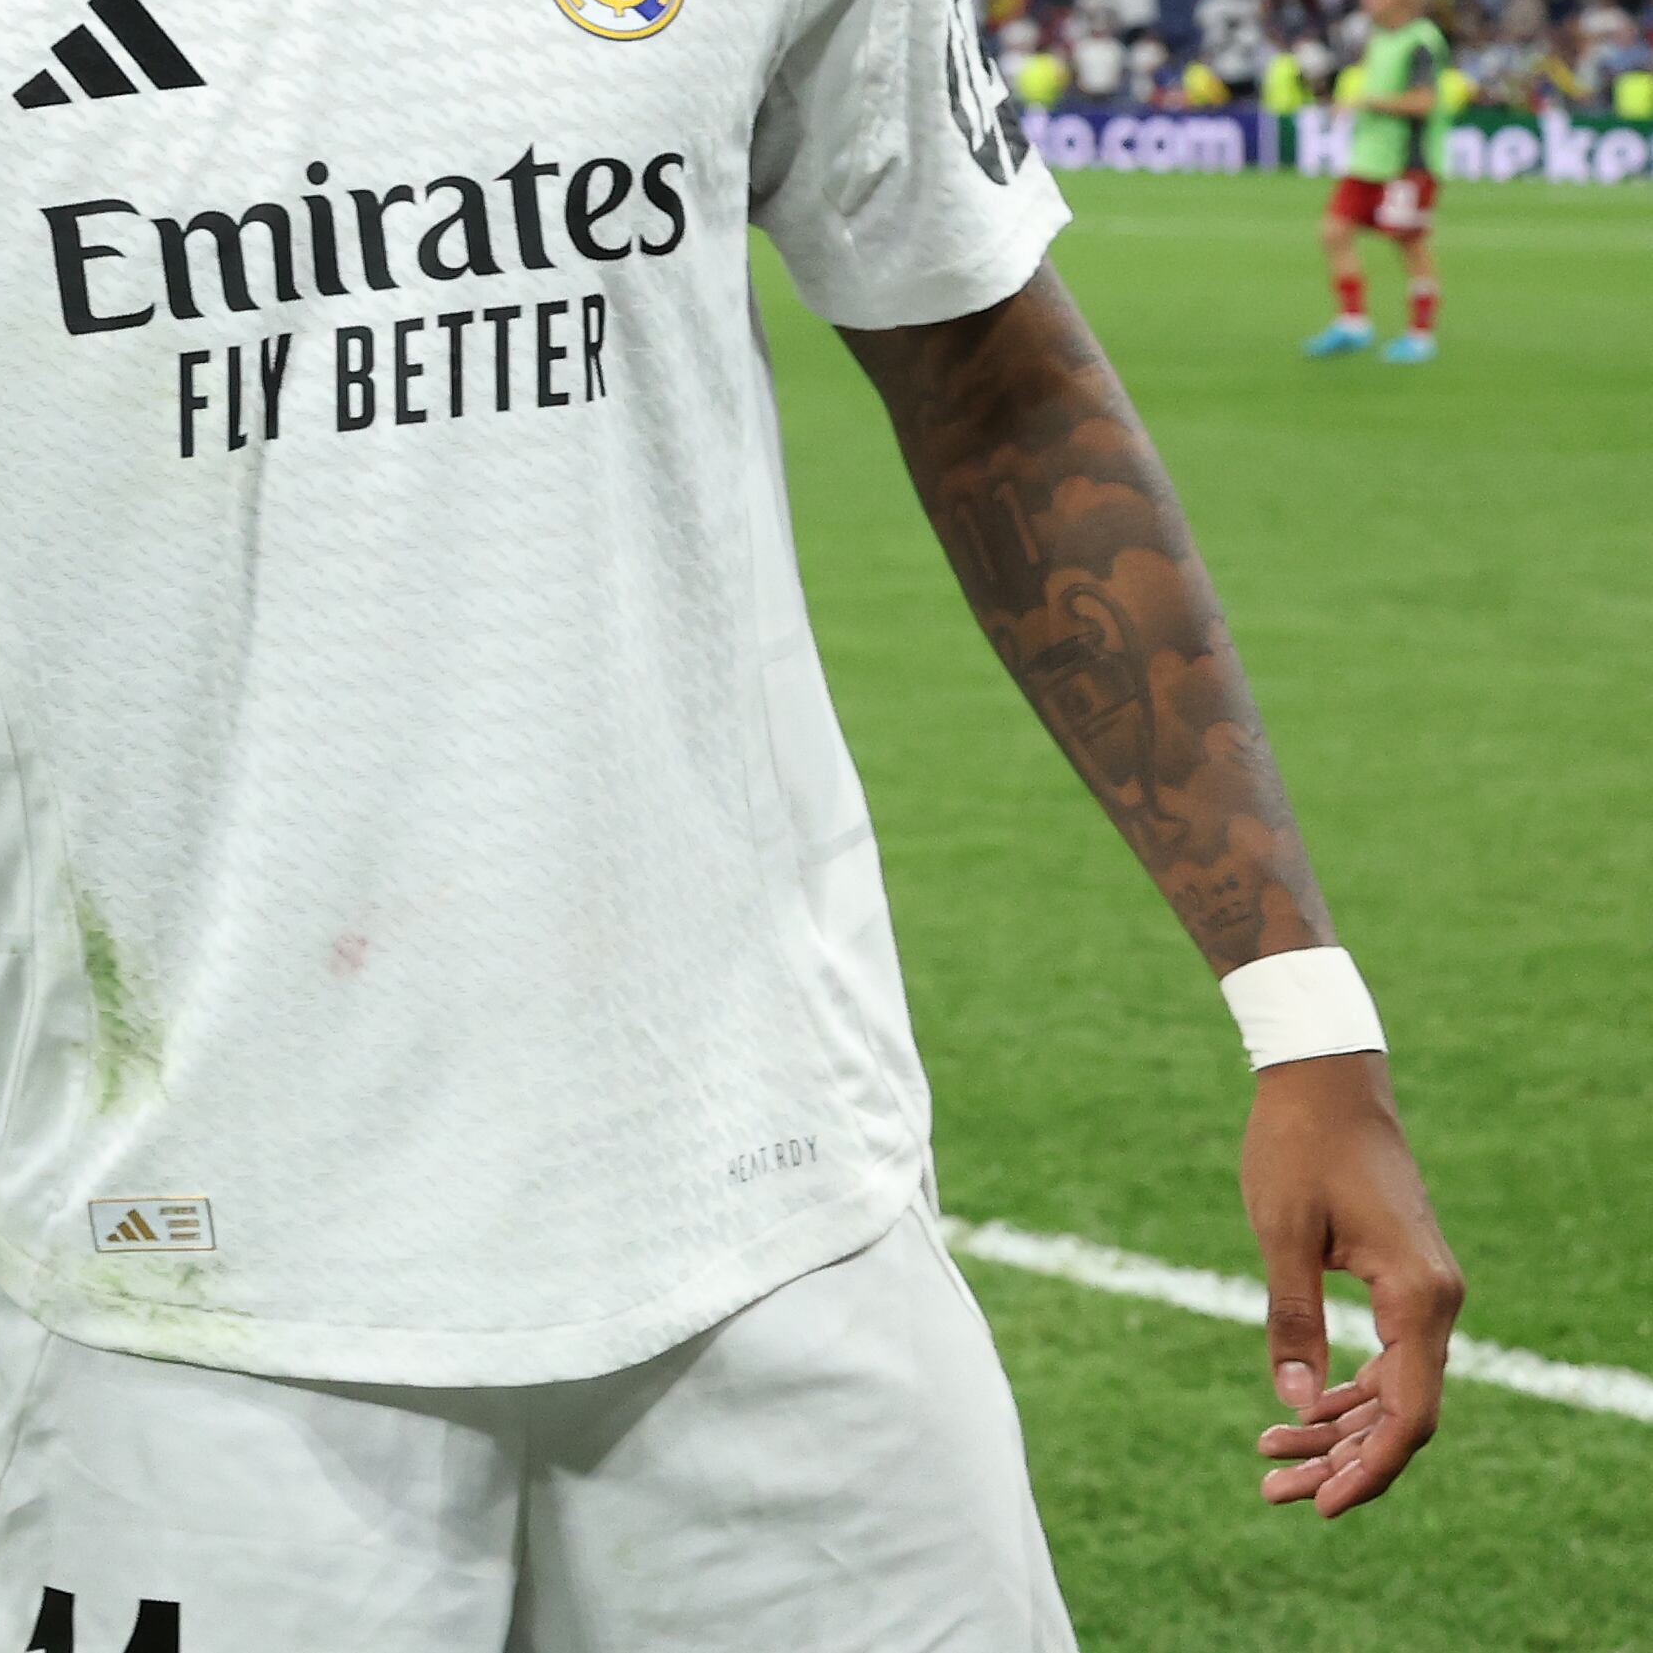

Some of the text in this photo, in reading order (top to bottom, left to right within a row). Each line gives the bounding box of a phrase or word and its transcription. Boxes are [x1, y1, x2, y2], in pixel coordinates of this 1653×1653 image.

[40, 143, 687, 336] Emirates
[179, 332, 293, 458] FLY
[335, 293, 608, 433] BETTER
